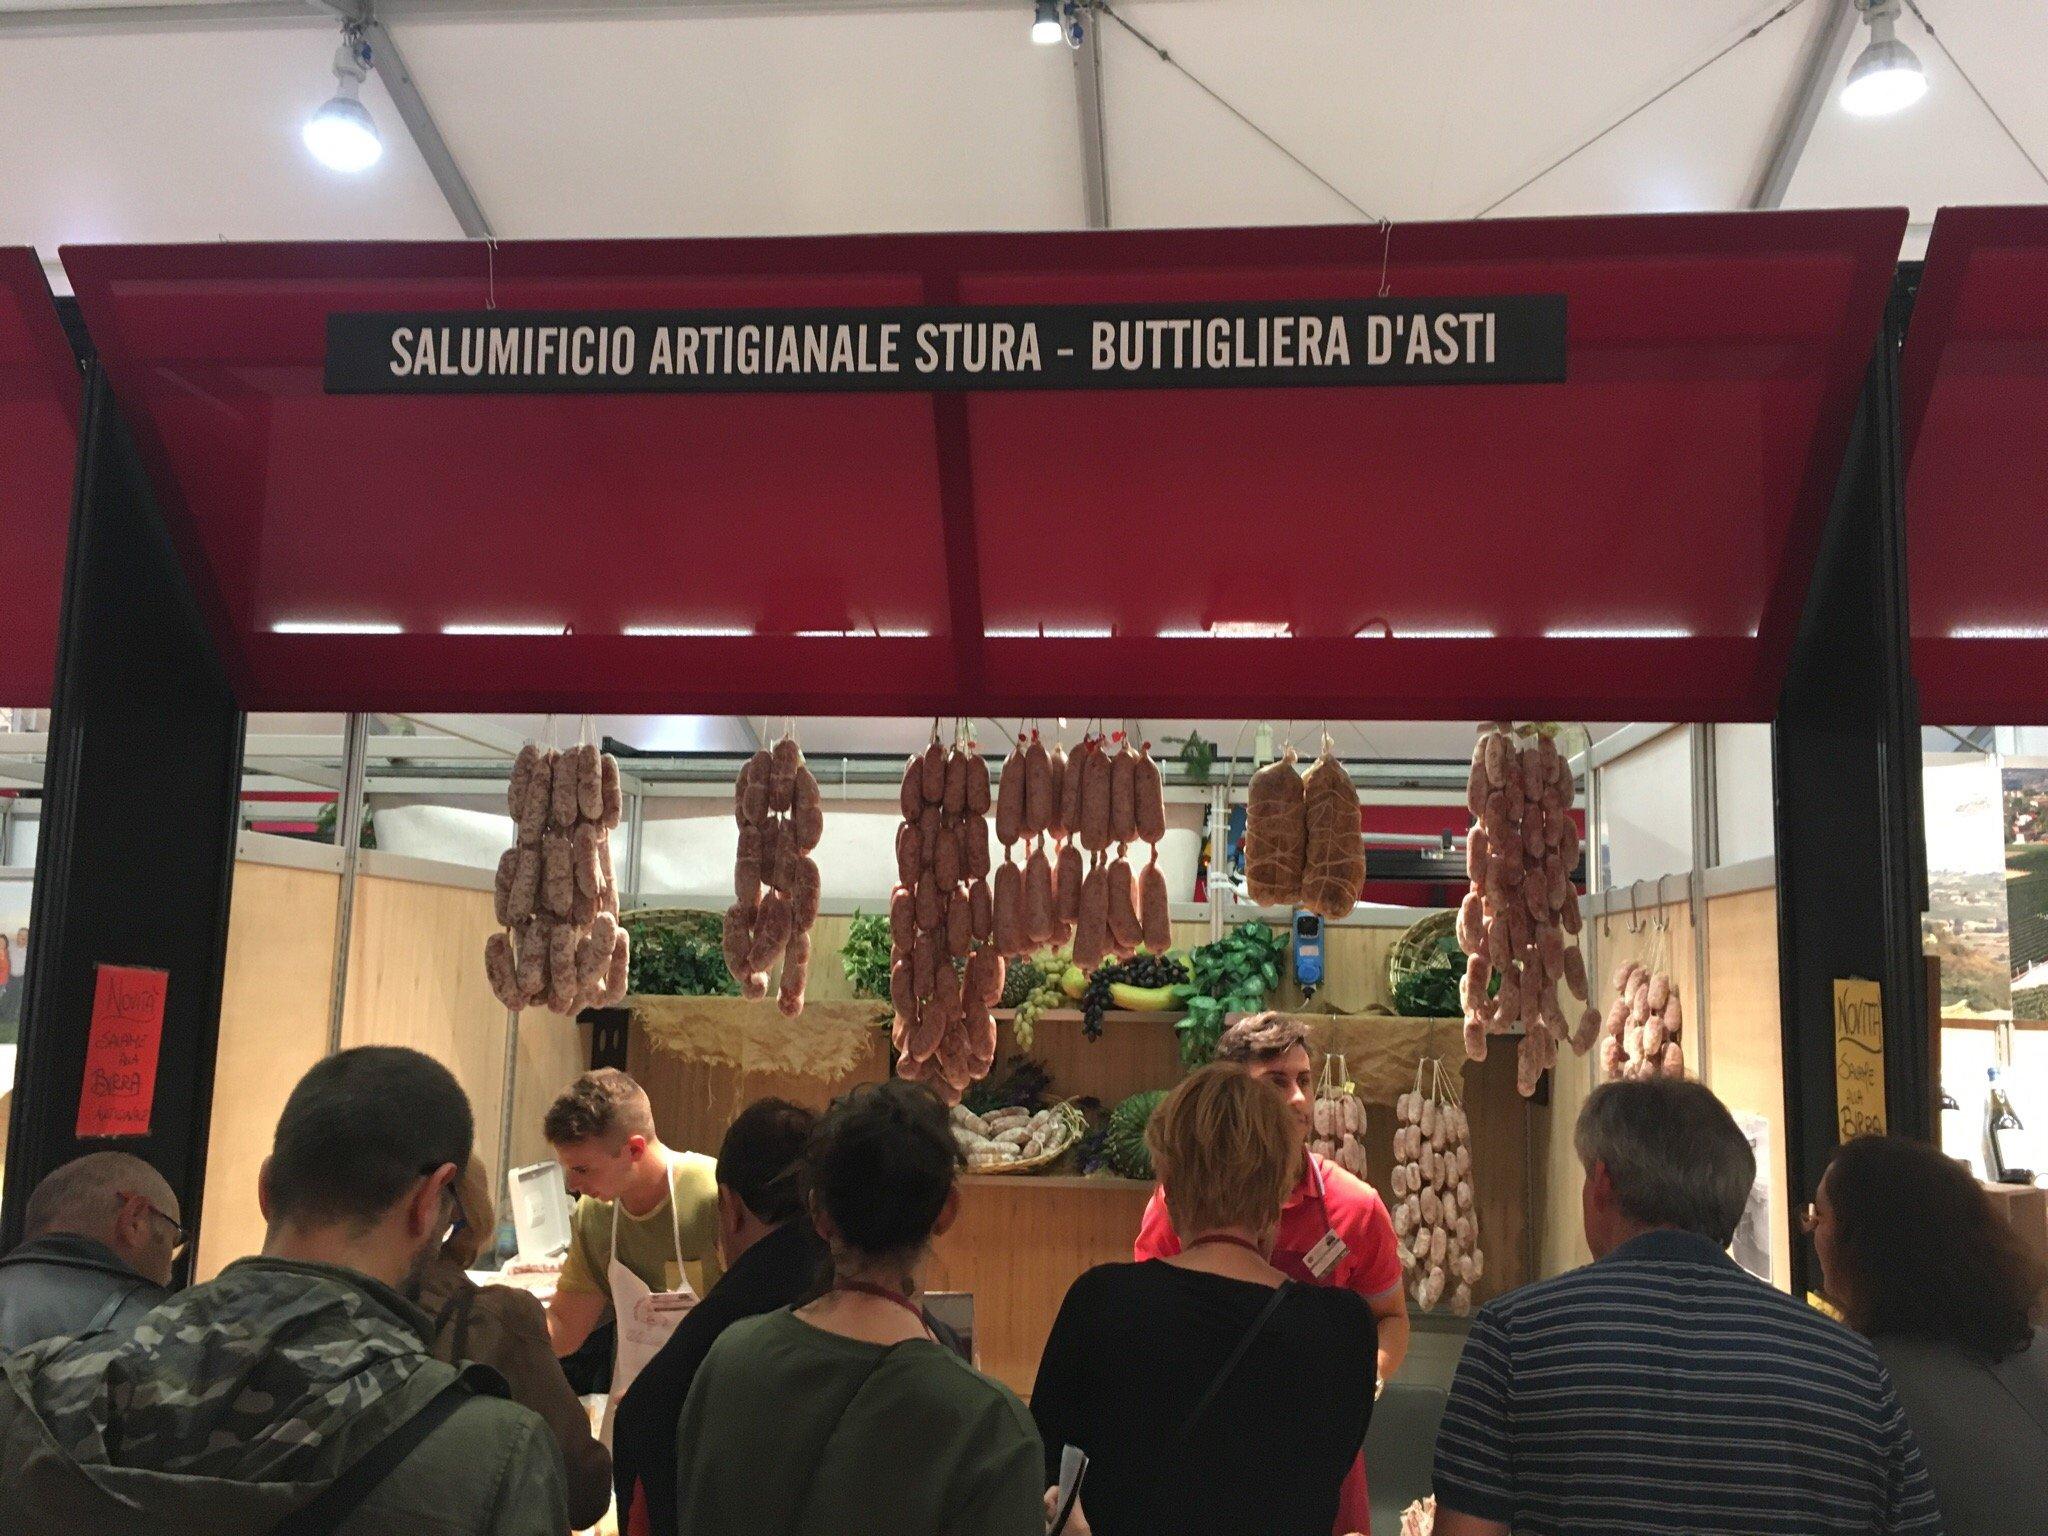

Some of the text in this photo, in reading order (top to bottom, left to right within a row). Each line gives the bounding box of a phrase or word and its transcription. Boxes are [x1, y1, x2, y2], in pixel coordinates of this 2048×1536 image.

[389, 326, 634, 375] SALUMIFICIO
[649, 324, 900, 374] ARTIGIANALE
[914, 322, 1041, 372] STURA
[1092, 316, 1350, 371] BUTTIGLIERA
[1367, 313, 1494, 364] D'ASTI
[91, 1069, 142, 1097] BIRRA
